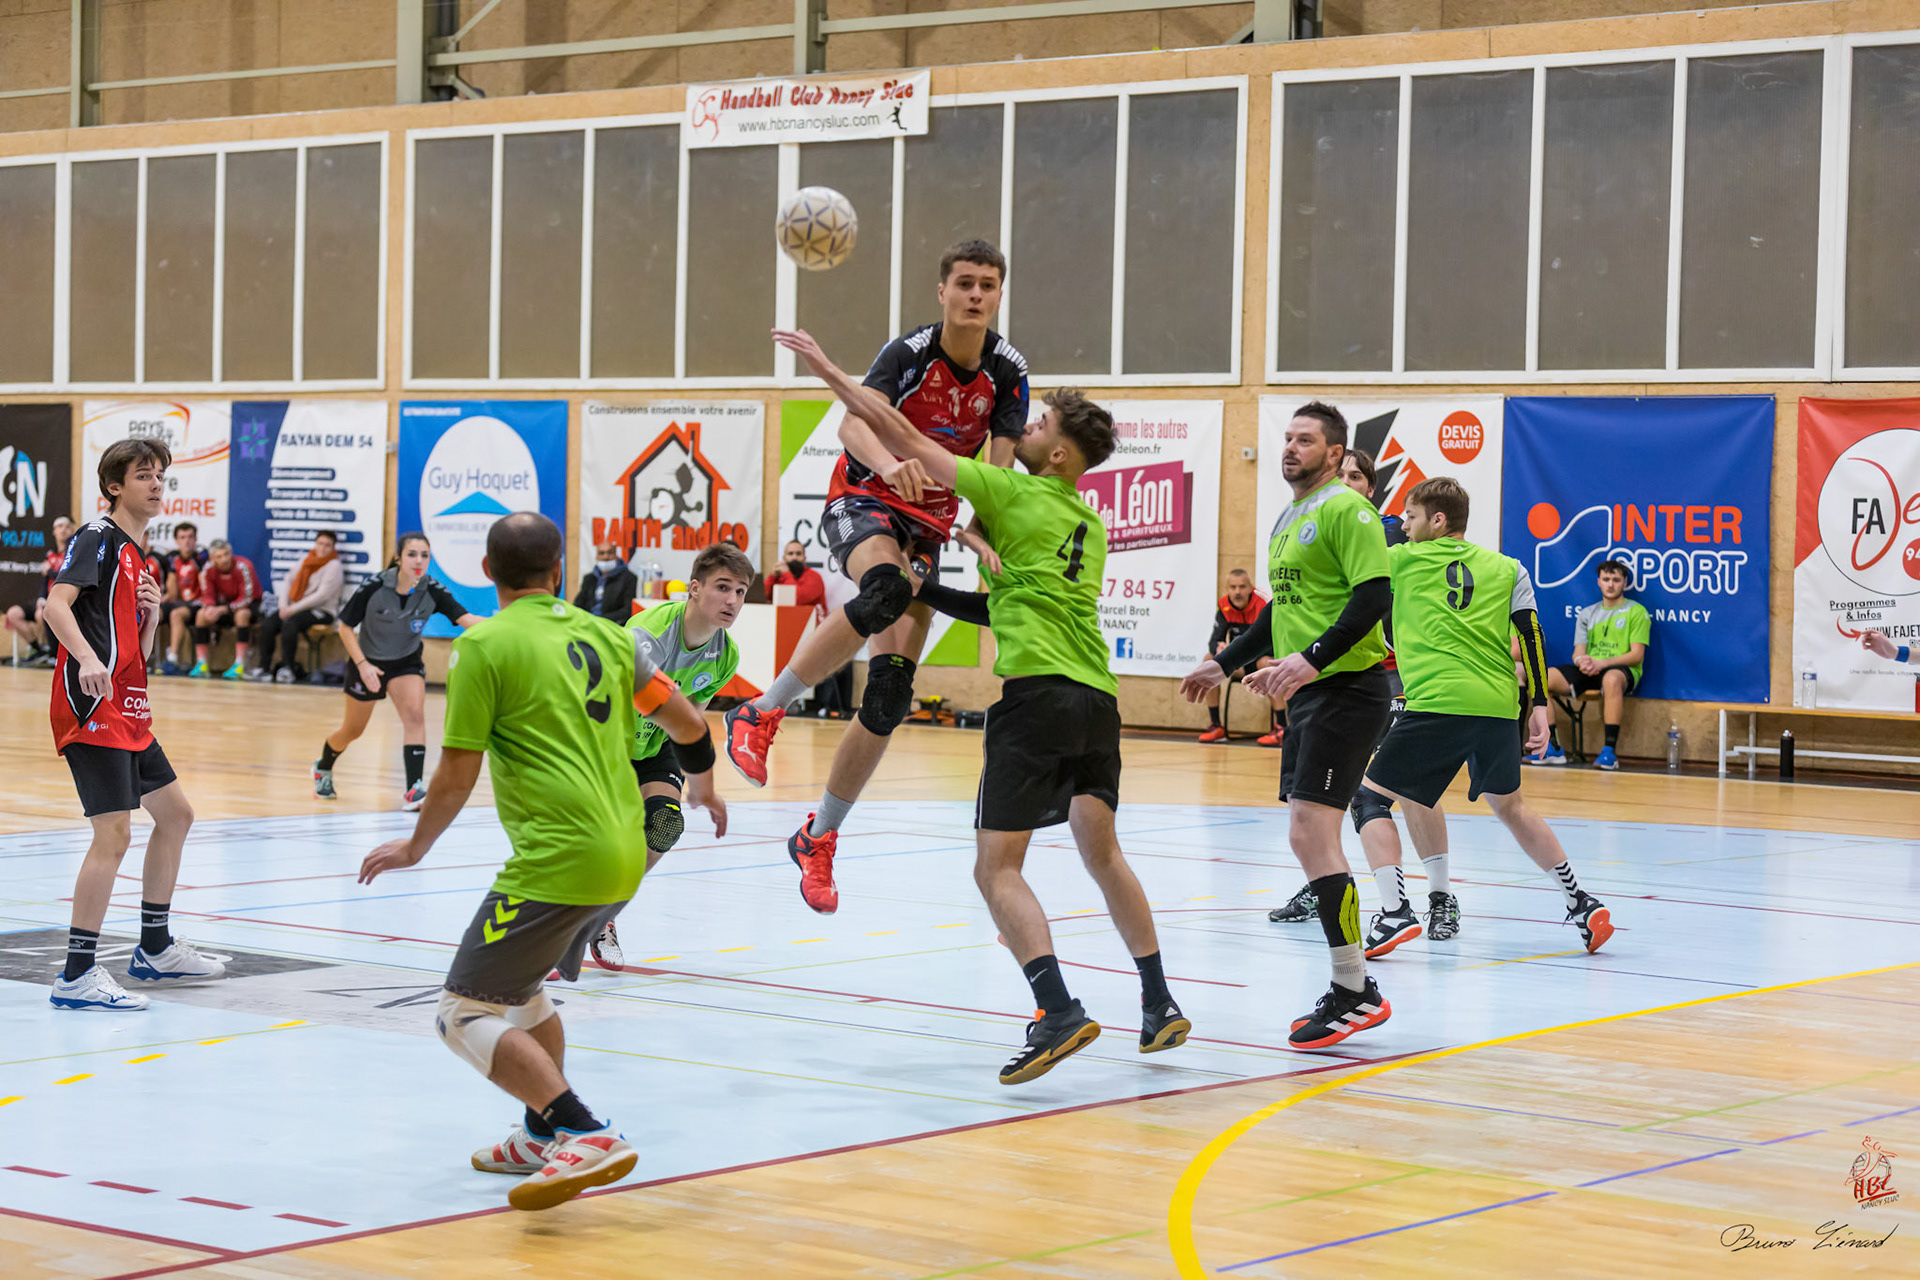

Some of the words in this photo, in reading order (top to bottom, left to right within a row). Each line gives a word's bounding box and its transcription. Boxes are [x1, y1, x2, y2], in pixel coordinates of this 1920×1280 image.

[720, 86, 783, 110] Handball
[790, 85, 823, 106] Club
[738, 113, 880, 133] www.hbcnancysluc.com
[589, 405, 648, 415] Construisons
[650, 406, 696, 415] ensemble
[699, 407, 724, 415] votre
[726, 406, 757, 416] avenir
[1113, 422, 1138, 438] mme
[1140, 418, 1154, 438] les
[1157, 418, 1188, 439] autres
[1442, 425, 1480, 438] DEVIS
[280, 434, 322, 446] RAYAN
[325, 435, 354, 447] DEM
[802, 445, 845, 456] Afterwor
[1112, 443, 1161, 455] deleon.fr
[1441, 439, 1480, 450] GRATUIT
[428, 466, 462, 494] Guy
[466, 467, 530, 493] Hoquet
[1114, 470, 1173, 529] Léon
[592, 517, 661, 548] BATIM
[671, 520, 711, 550] and
[1122, 523, 1172, 537] SPIRITUEUX
[1612, 503, 1743, 544] INTER
[1055, 520, 1088, 583] 4
[1126, 536, 1168, 550] particuliers
[1273, 534, 1289, 559] 11
[1607, 548, 1747, 594] SPORT
[1123, 579, 1146, 599] 84
[1152, 580, 1175, 600] 57
[1446, 560, 1474, 611] 9
[1130, 605, 1150, 616] Brot
[1829, 598, 1896, 611] Programmes
[1857, 609, 1882, 620] Infos
[1103, 619, 1138, 631] NANCY
[566, 640, 611, 724] 2
